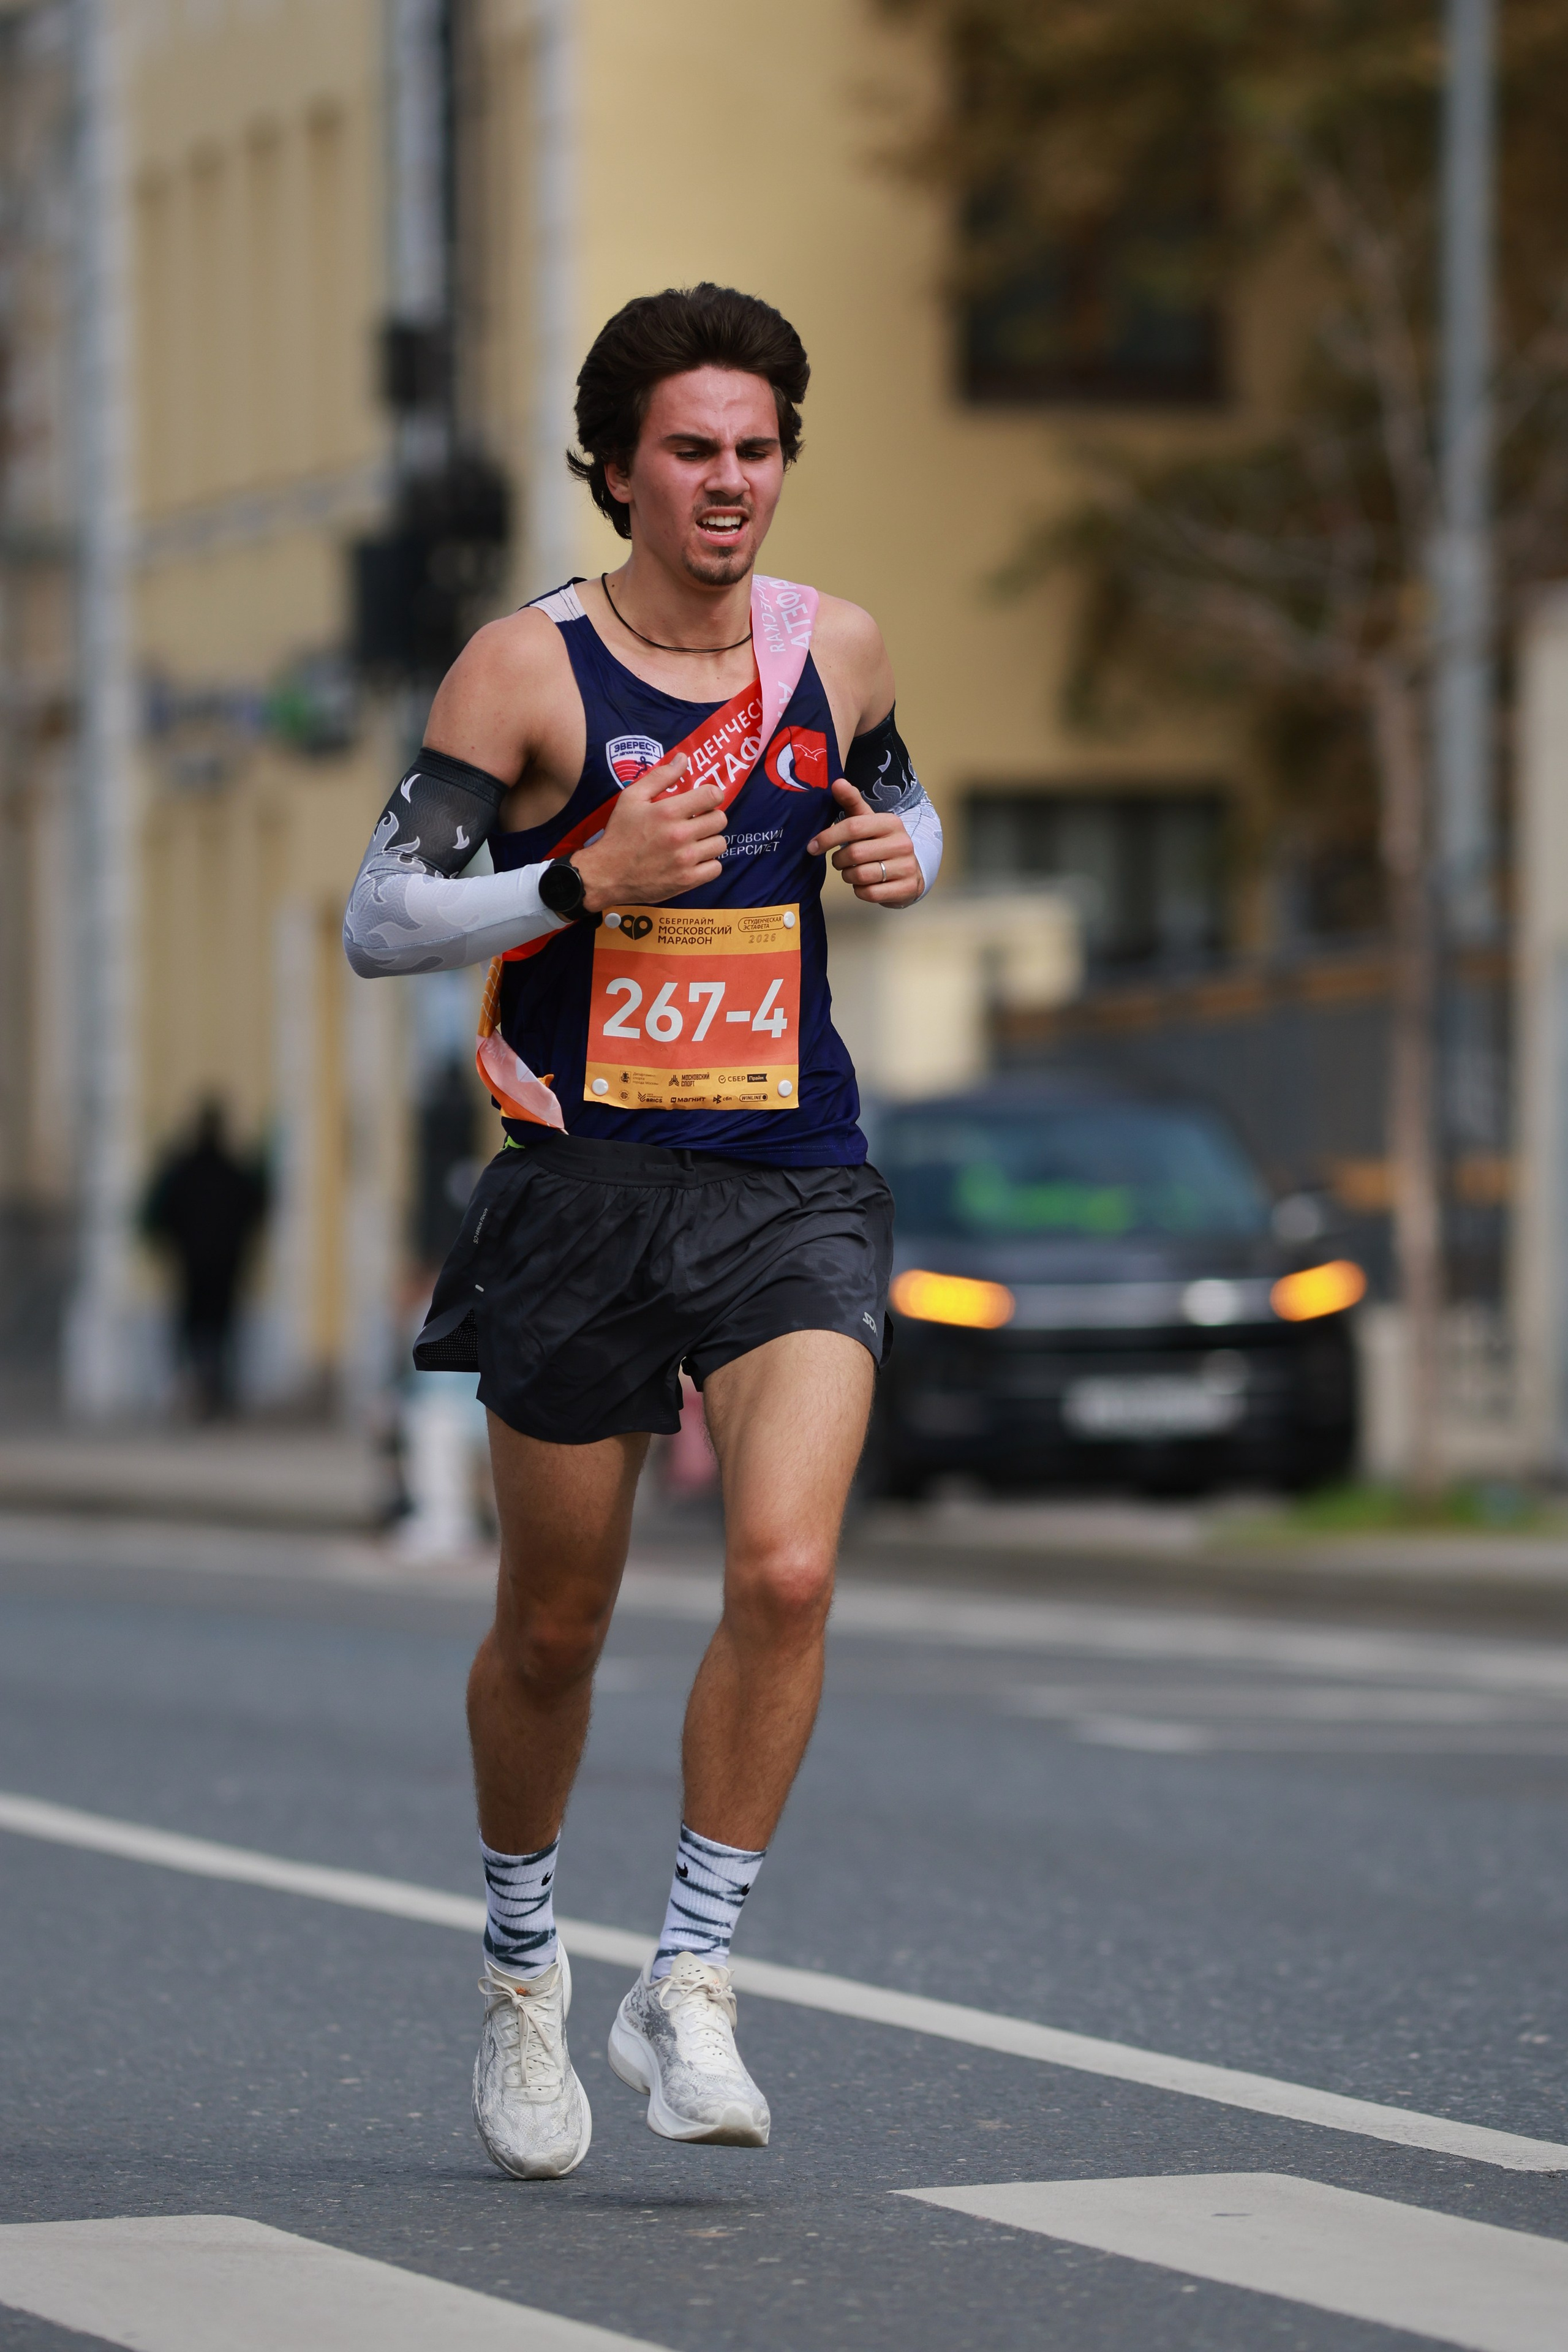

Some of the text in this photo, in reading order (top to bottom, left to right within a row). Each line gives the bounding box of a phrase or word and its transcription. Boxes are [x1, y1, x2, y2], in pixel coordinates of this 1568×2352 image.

[614, 741, 656, 753] ЭВЕРЕСТ
[744, 916, 782, 925] СТУДЕНЧЕСКАЯ
[658, 925, 732, 935] МОСКОВСКИЙ
[658, 935, 712, 944] МАРАФОН
[748, 933, 777, 944] 2026
[603, 977, 788, 1042] 267-4
[682, 1072, 710, 1081] МОСКОВСКИЙ
